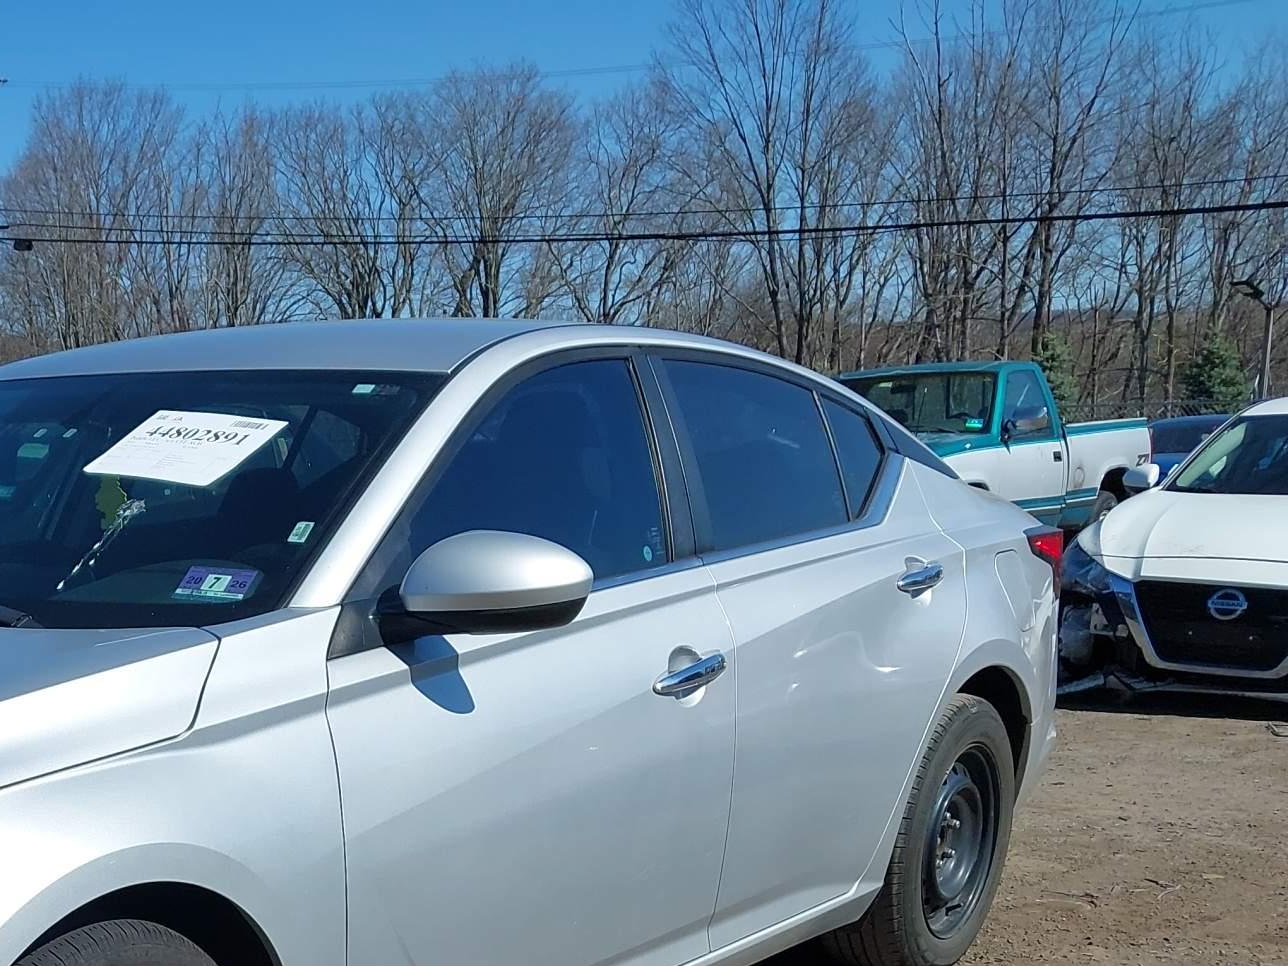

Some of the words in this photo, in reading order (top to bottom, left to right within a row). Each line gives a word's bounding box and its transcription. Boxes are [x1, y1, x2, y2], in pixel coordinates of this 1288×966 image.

[144, 424, 251, 446] 44802891
[185, 575, 203, 585] 20
[208, 576, 222, 589] 7
[230, 580, 247, 589] 26
